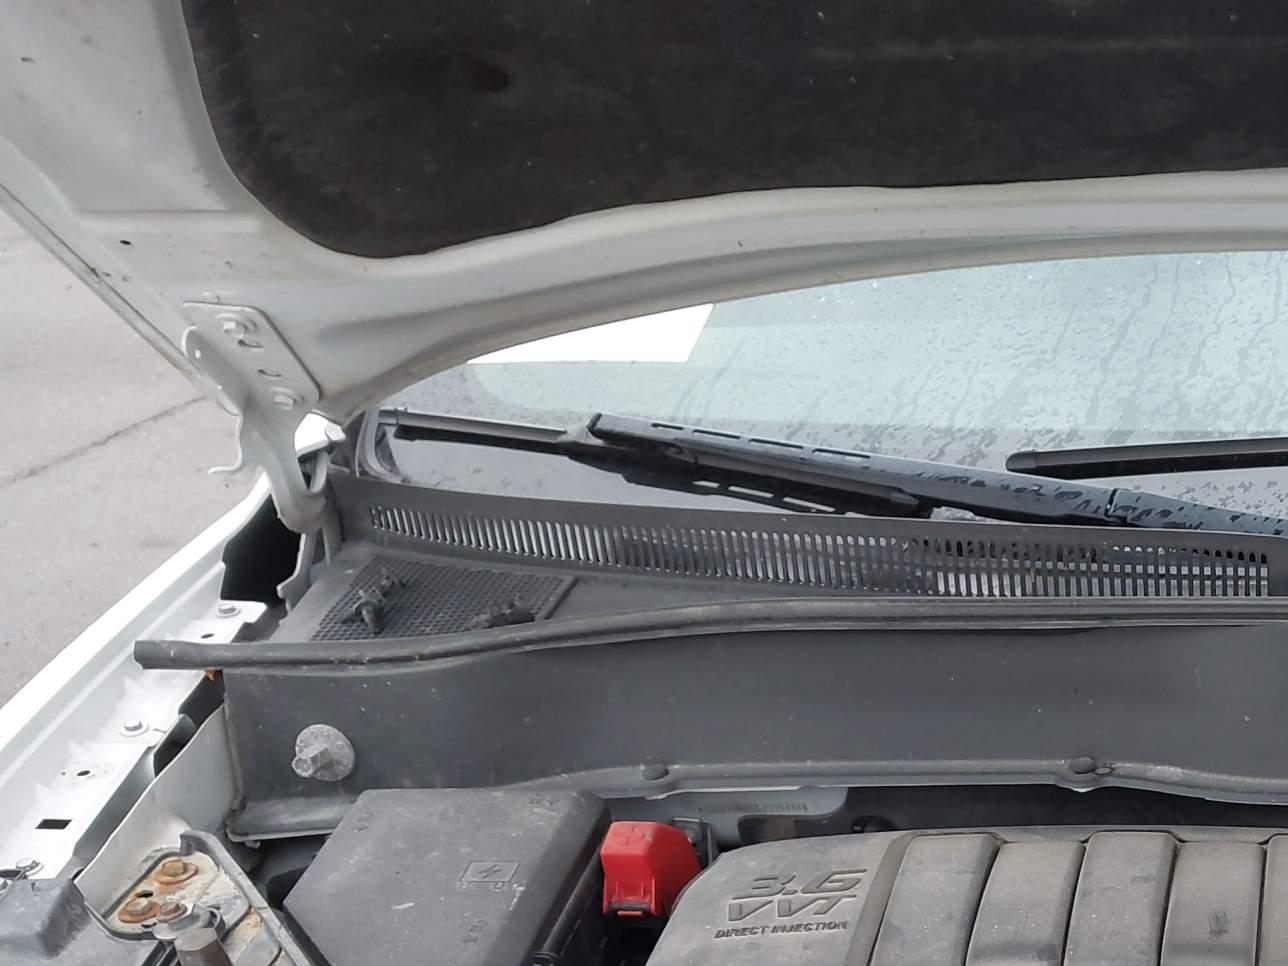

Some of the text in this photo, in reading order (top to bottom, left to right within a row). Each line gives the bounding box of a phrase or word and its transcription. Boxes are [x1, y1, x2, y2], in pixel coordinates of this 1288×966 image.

[732, 868, 868, 901] 3.6
[728, 893, 857, 922] VVT
[714, 919, 848, 939] DIRECT INJECTION
